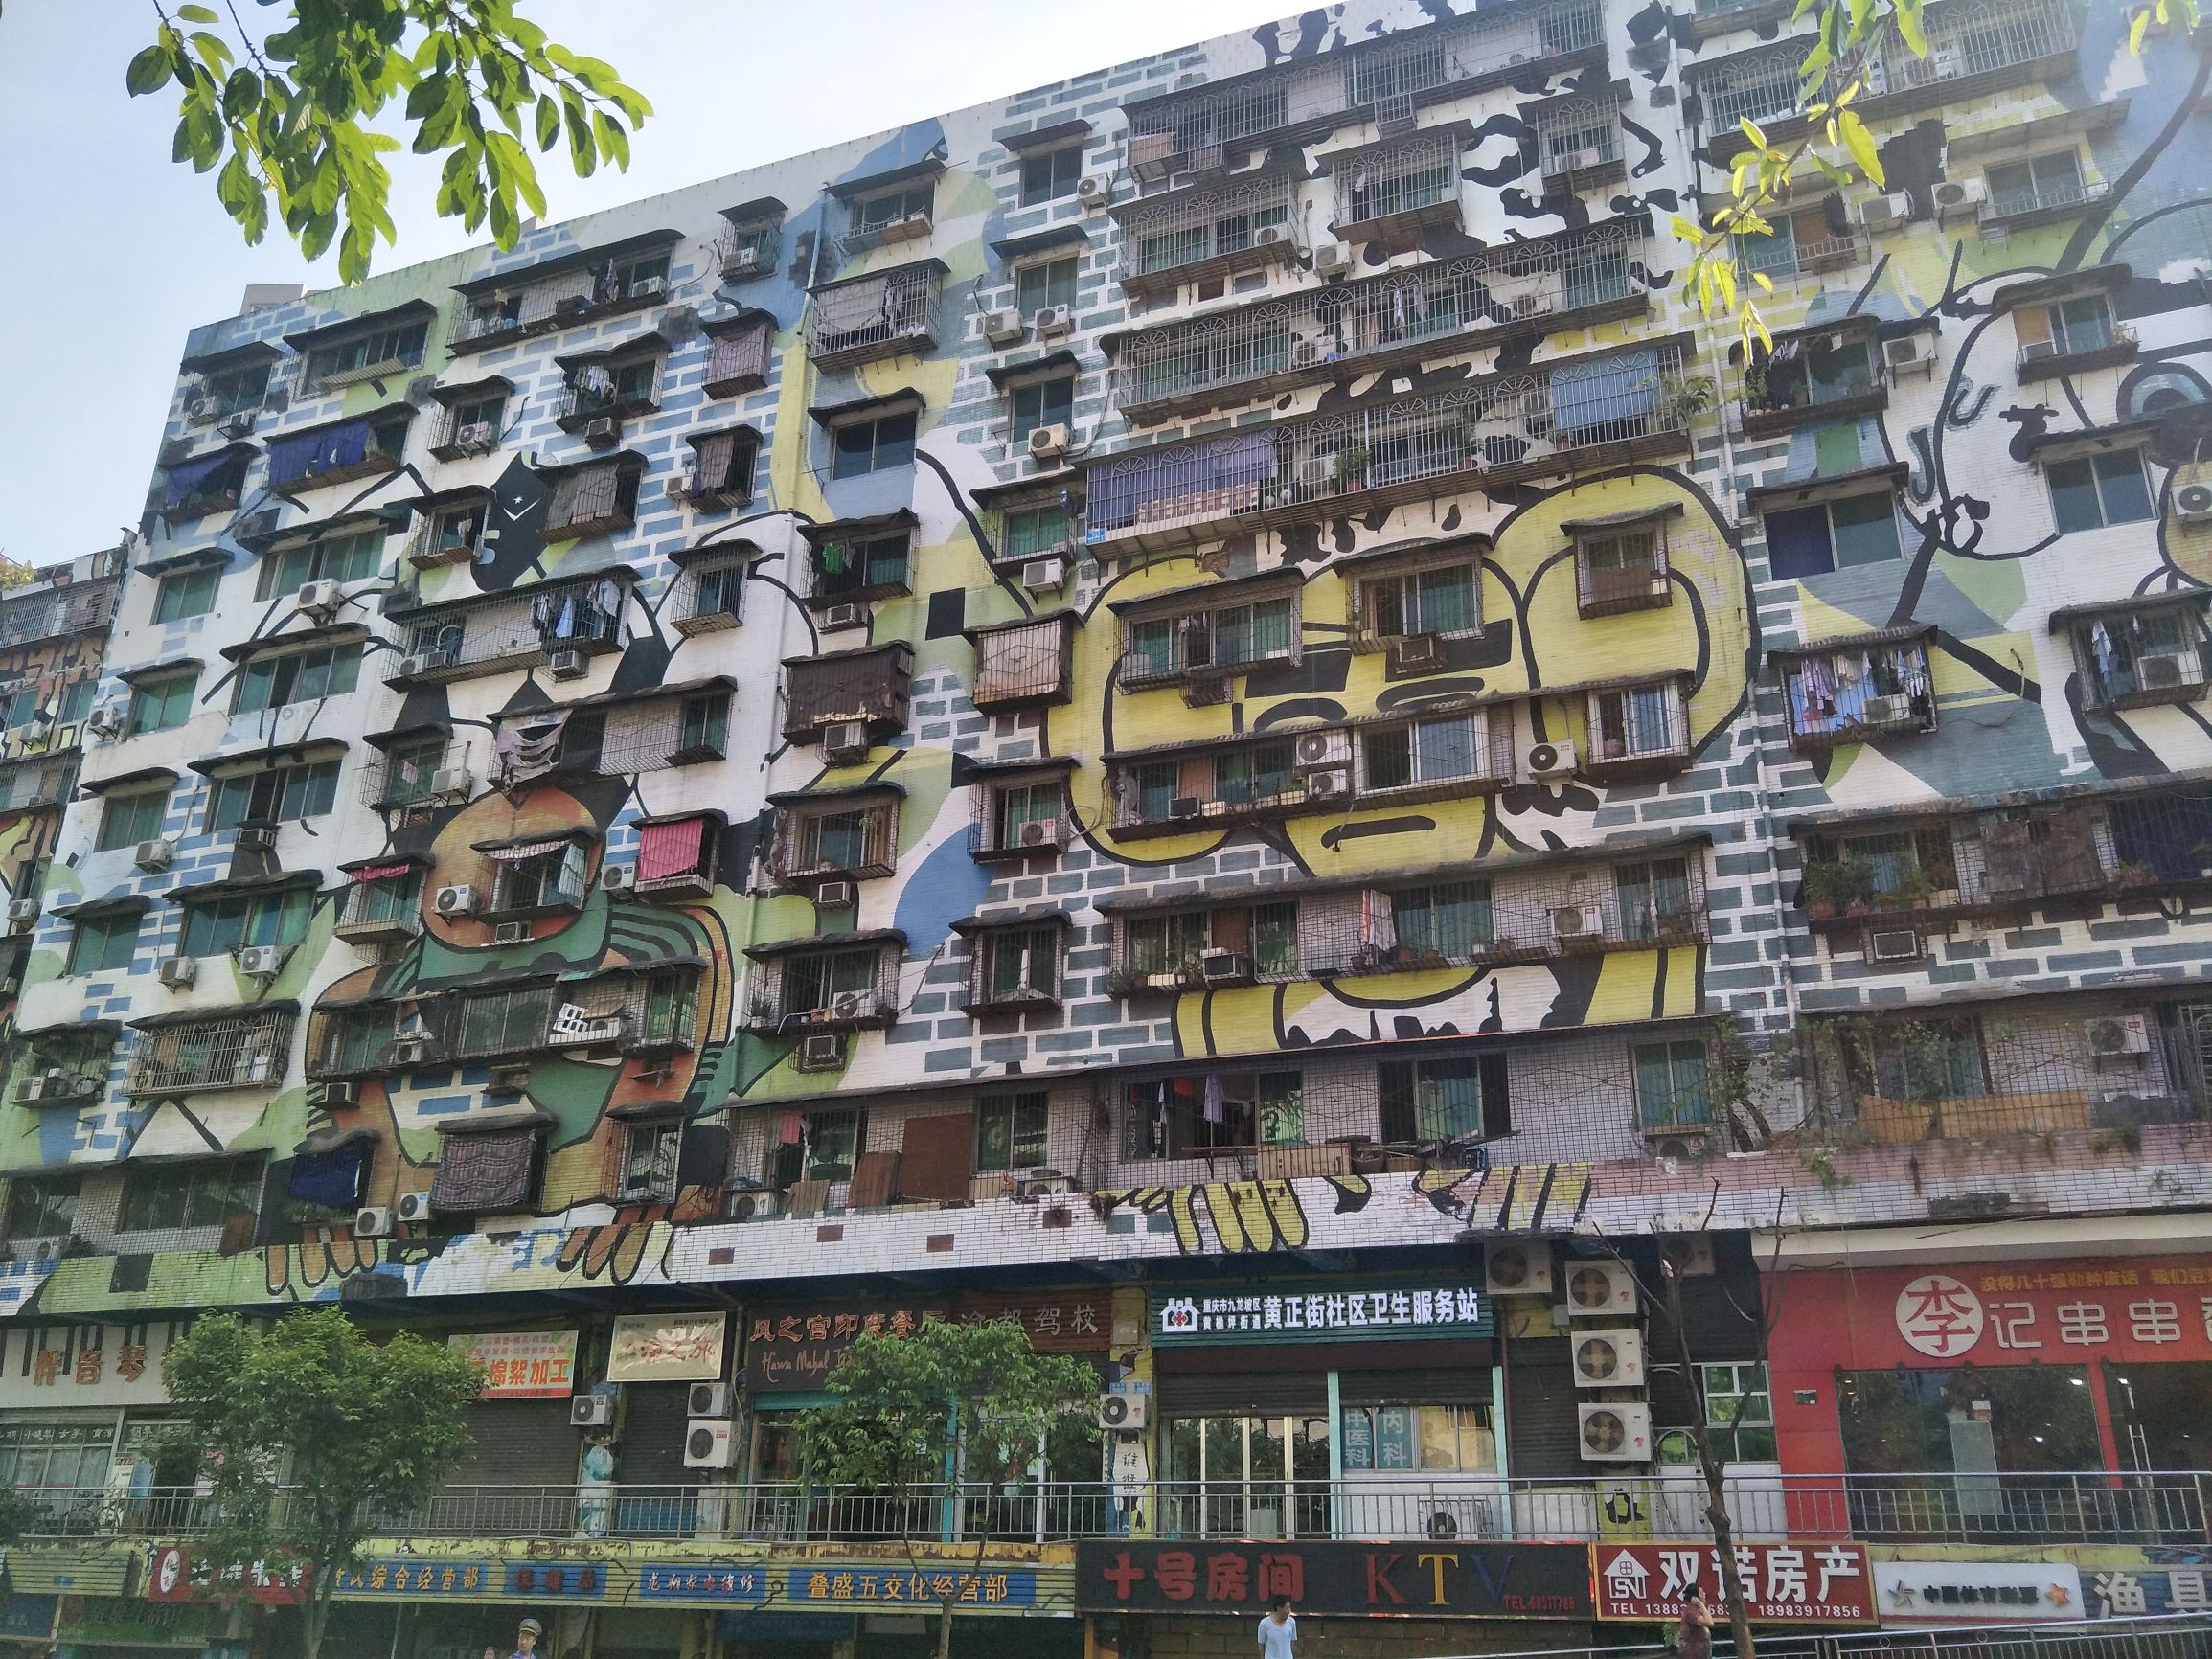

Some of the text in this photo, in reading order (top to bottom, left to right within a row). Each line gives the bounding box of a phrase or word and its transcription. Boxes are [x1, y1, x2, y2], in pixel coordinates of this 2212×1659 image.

[1203, 1298, 1261, 1313] 重庆市九龙坡区
[1264, 1287, 1479, 1329] 黄正街社区卫生服务站
[1345, 1410, 1371, 1466] 中医科
[1383, 1410, 1407, 1466] 内科
[808, 1572, 1009, 1602] 叠盛五交化经营部
[1103, 1552, 1516, 1605] 十号房间 KTV
[1658, 1545, 1860, 1603] 双诺房产
[1610, 1602, 1638, 1615] TEL
[1759, 1604, 1861, 1618] 18983917856
